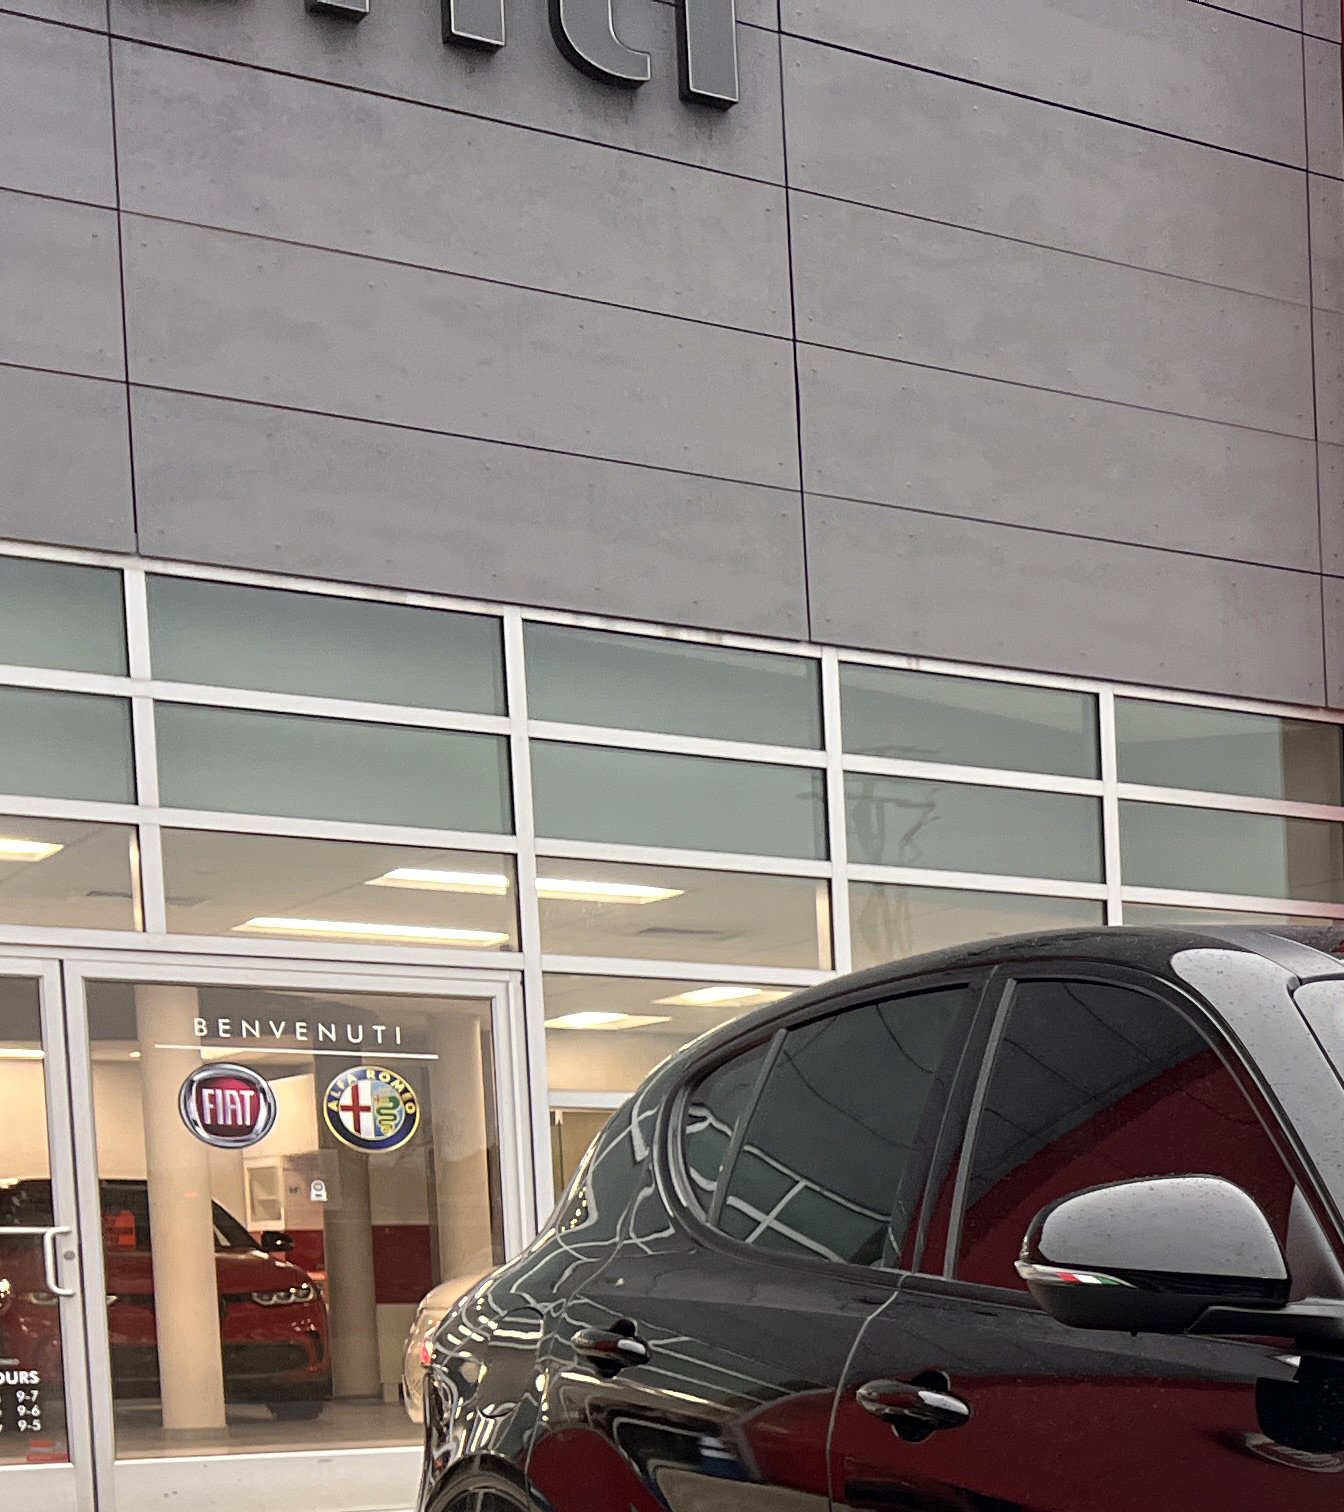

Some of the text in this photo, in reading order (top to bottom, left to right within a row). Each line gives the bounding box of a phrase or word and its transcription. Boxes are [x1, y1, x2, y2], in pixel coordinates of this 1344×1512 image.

[193, 1018, 401, 1045] BENVENUTI
[327, 1069, 417, 1115] ALFA ROMEO
[202, 1088, 255, 1126] FIAT
[16, 1390, 39, 1402] 9-7
[17, 1404, 41, 1417] 9-6
[18, 1419, 41, 1432] 9-5
